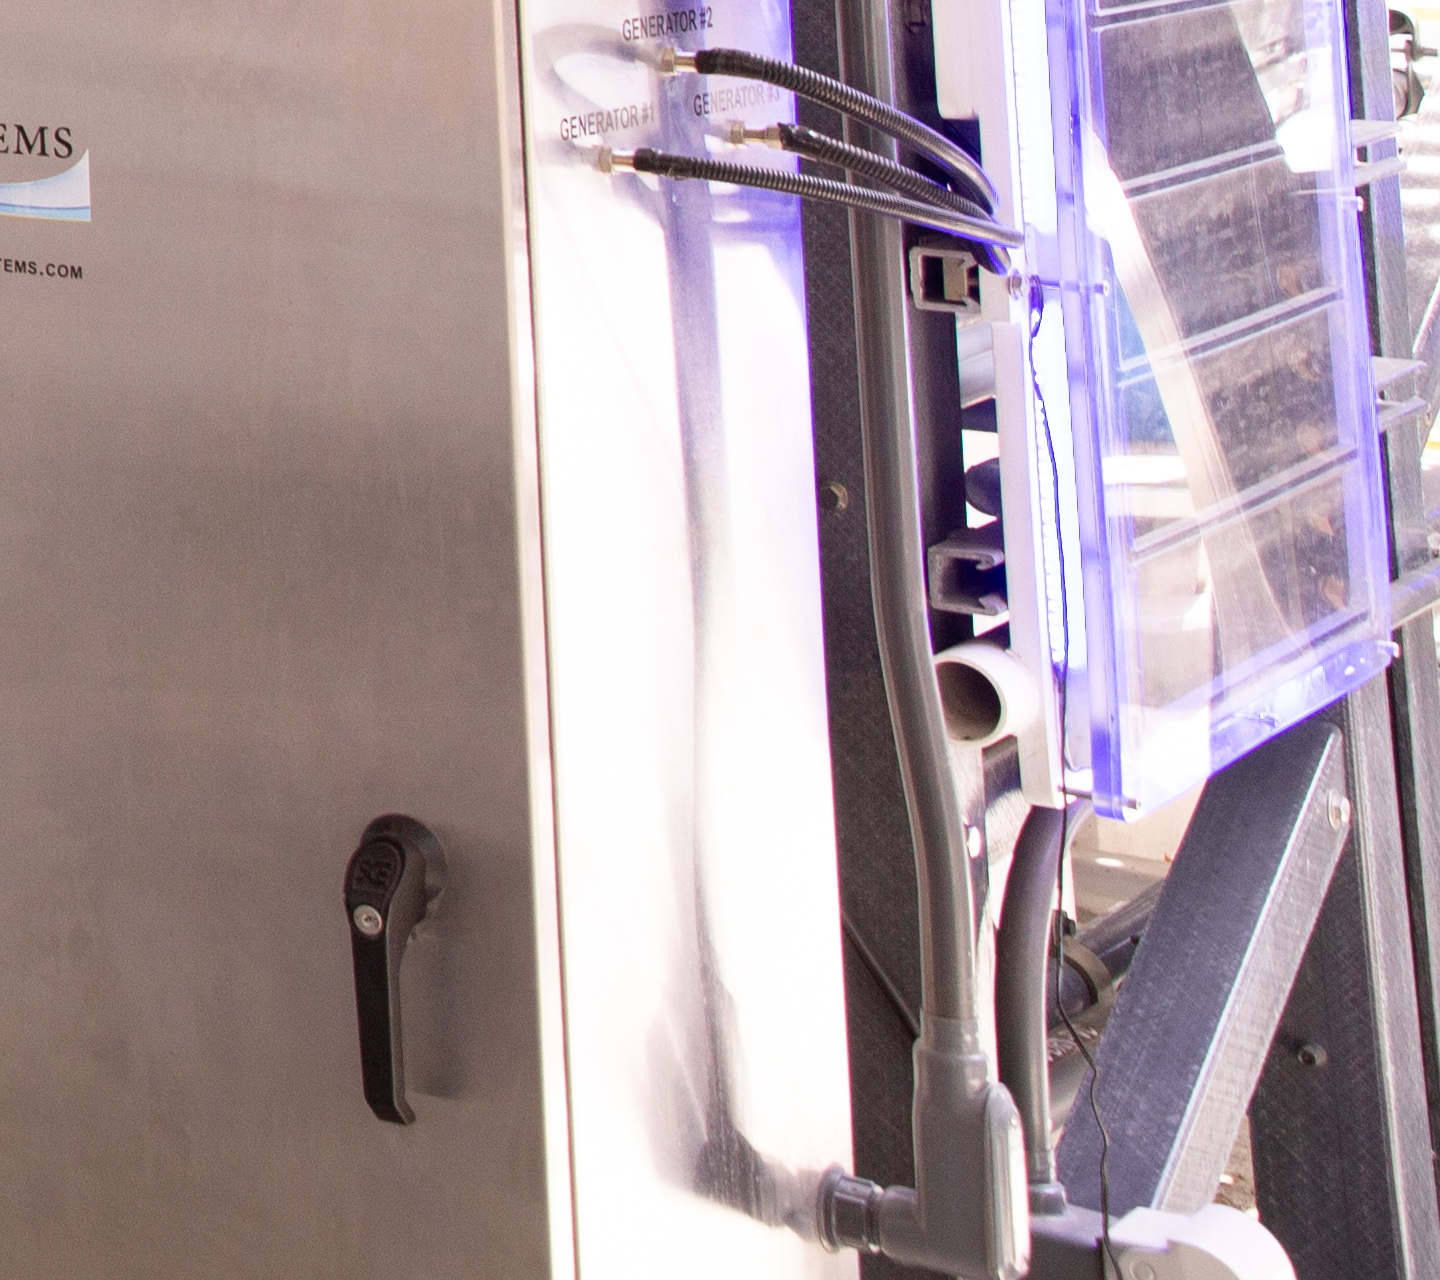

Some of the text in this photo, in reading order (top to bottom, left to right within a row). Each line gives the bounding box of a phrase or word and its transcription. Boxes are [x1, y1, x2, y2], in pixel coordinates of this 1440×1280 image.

[622, 6, 713, 41] GENERATOR #2
[693, 83, 765, 117] GENERATOR
[560, 102, 656, 141] GENERATOR #1
